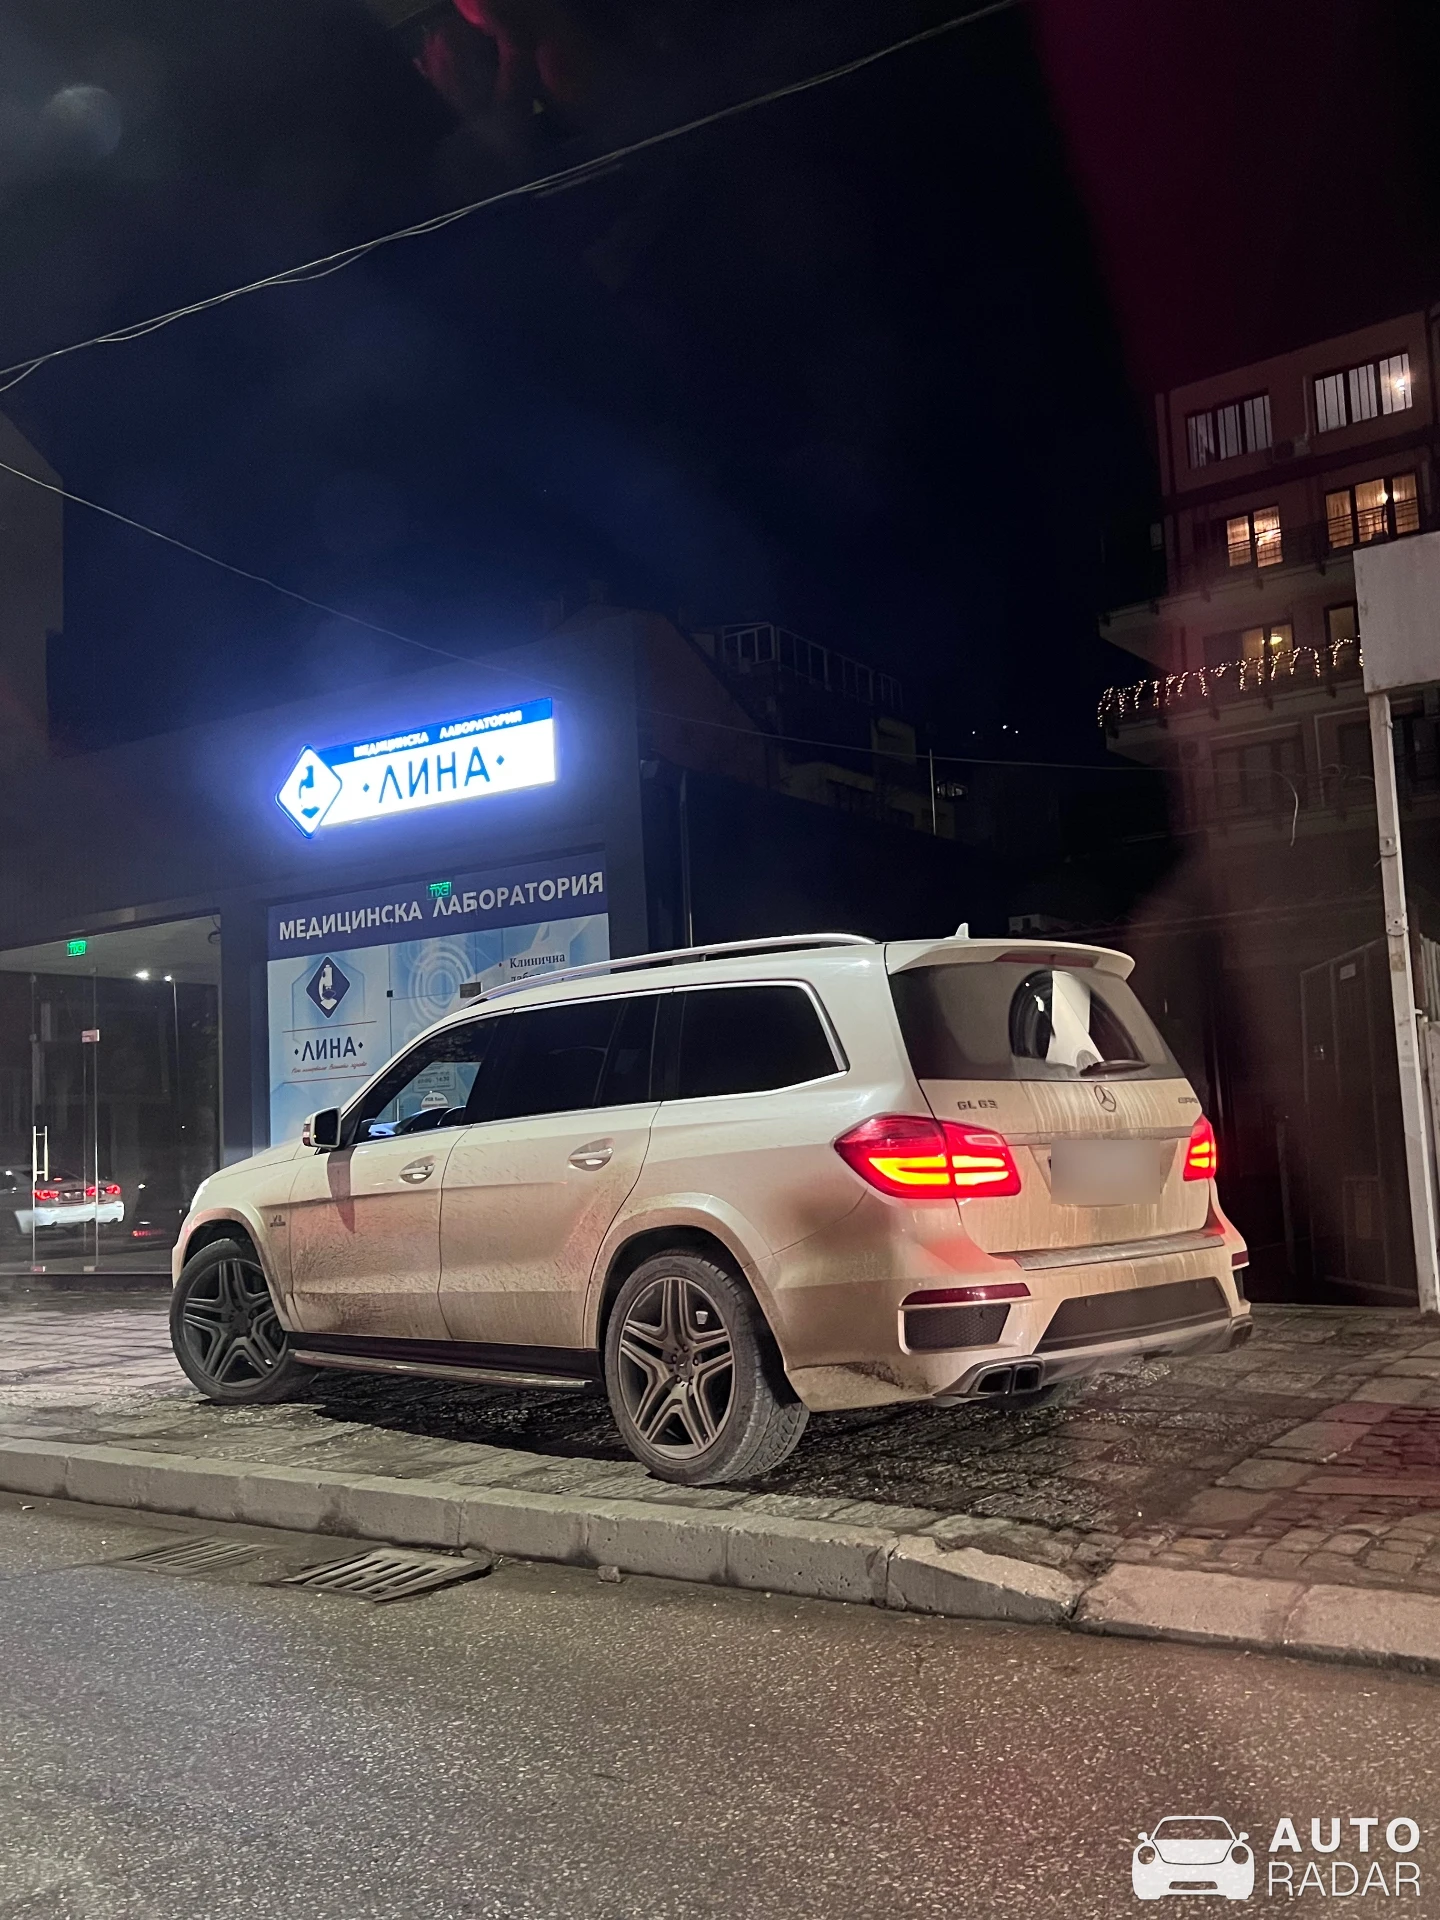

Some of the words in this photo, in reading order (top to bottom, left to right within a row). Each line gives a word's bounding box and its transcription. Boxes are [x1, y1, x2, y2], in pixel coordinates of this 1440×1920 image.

[353, 731, 429, 758] МЕДИЦИНСКА
[439, 710, 523, 740] ЛАБОРАТОРИЯ
[378, 746, 491, 804] ЛИНА
[279, 901, 423, 941] МЕДИЦИНСКА
[432, 871, 604, 918] ЛАБОРАТОРИЯ
[509, 953, 566, 969] Клинична
[301, 1036, 357, 1062] ЛИНА
[957, 1101, 977, 1110] GL
